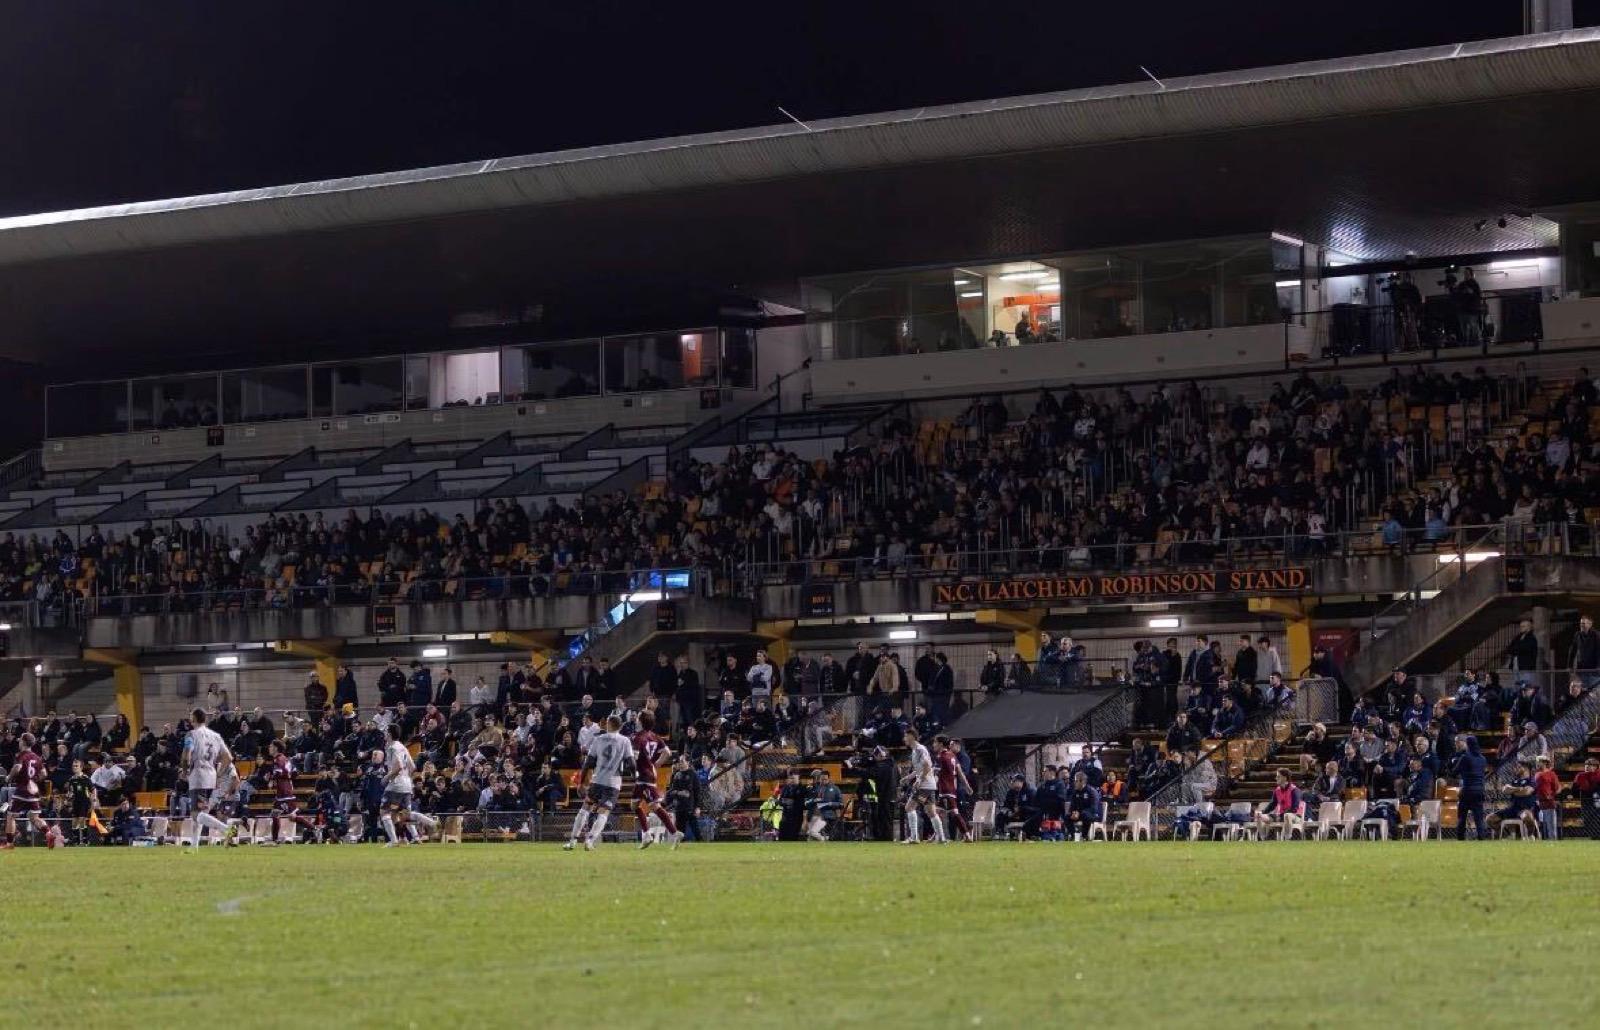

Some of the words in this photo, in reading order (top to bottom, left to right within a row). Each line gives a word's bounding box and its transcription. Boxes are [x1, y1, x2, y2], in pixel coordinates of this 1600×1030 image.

[937, 584, 974, 602] N.C.
[978, 577, 1094, 601] (LATCHEM)
[1101, 573, 1216, 596] ROBINSON
[1230, 569, 1304, 590] STAND
[28, 760, 36, 777] 6
